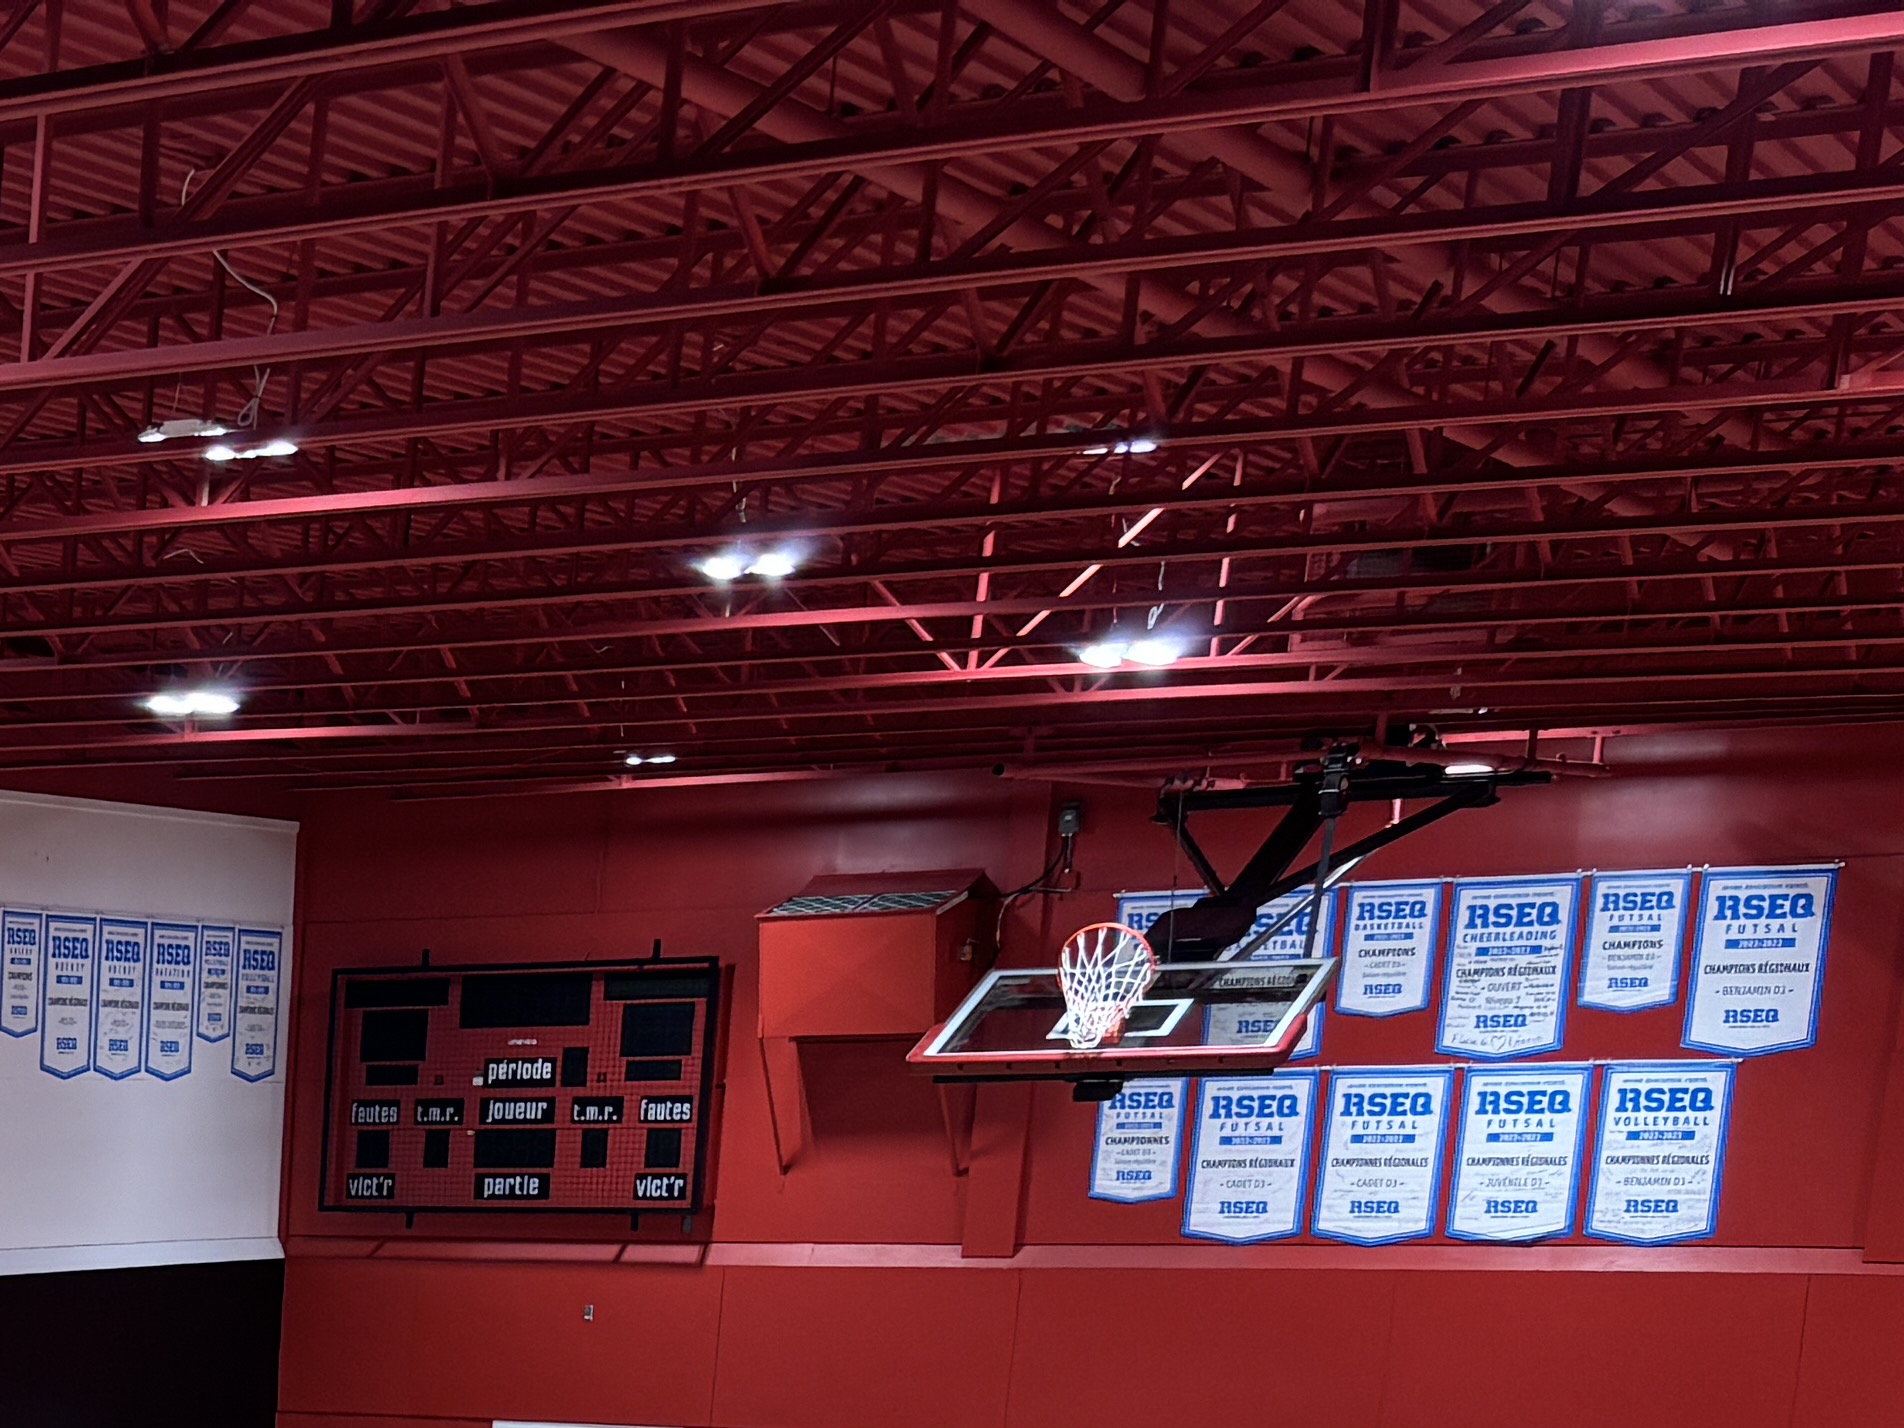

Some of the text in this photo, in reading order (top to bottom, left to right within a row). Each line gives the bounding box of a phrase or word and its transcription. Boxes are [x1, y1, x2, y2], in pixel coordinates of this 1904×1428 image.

[1600, 891, 1676, 912] RSEQ
[1713, 893, 1816, 921] RSEQ
[1356, 900, 1428, 921] RSEQ
[1464, 901, 1561, 930] RSEQ
[1609, 914, 1662, 922] FUTSAL
[1354, 922, 1424, 931] BASKETBALL
[1725, 923, 1798, 935] FUTSAL
[7, 927, 36, 946] RSEQ
[1462, 930, 1557, 943] CHEERLEADING
[52, 935, 90, 960] RSEQ
[105, 939, 142, 963] RSEQ
[1358, 947, 1416, 958] CHAMPIONS
[1602, 940, 1664, 950] CHAMPIONS
[156, 943, 191, 966] RSEQ
[242, 949, 276, 971] RSEQ
[1456, 963, 1557, 979] CHAMPIONS RÉGIONAUX
[1704, 961, 1810, 975] CHAMPIONS RÉGIONAUX
[1363, 983, 1403, 995] RSEQ
[1487, 982, 1522, 992] OUVERT
[1607, 977, 1649, 989] RSEQ
[1474, 1014, 1528, 1029] RSEQ
[1723, 1008, 1780, 1024] RSEQ
[1236, 1019, 1279, 1034] RSE
[487, 1058, 552, 1084] période
[1108, 1091, 1175, 1110] RSEQ
[1209, 1094, 1299, 1119] RSEQ
[1340, 1092, 1433, 1117] RSEQ
[1475, 1090, 1572, 1115] RSEQ
[1614, 1087, 1715, 1113] RSEQ
[352, 1102, 398, 1123] fautes
[417, 1105, 459, 1122] t.m.r.
[486, 1100, 547, 1123] joueur
[573, 1104, 618, 1121] t.m.r.
[640, 1099, 691, 1120] fautes
[1219, 1121, 1284, 1132] FUTSAL
[1351, 1120, 1418, 1131] FUTSAL
[1486, 1118, 1556, 1129] FUTSAL
[1613, 1116, 1710, 1126] VOLLEYBALL
[1105, 1136, 1170, 1146] CHAMPIONNES
[1115, 1170, 1152, 1181] RSEQ
[483, 1175, 539, 1198] partie
[1218, 1200, 1268, 1214] RSEQ
[1349, 1200, 1400, 1214] RSEQ
[1484, 1200, 1538, 1214] RSEQ
[1623, 1199, 1679, 1213] RSEQ
